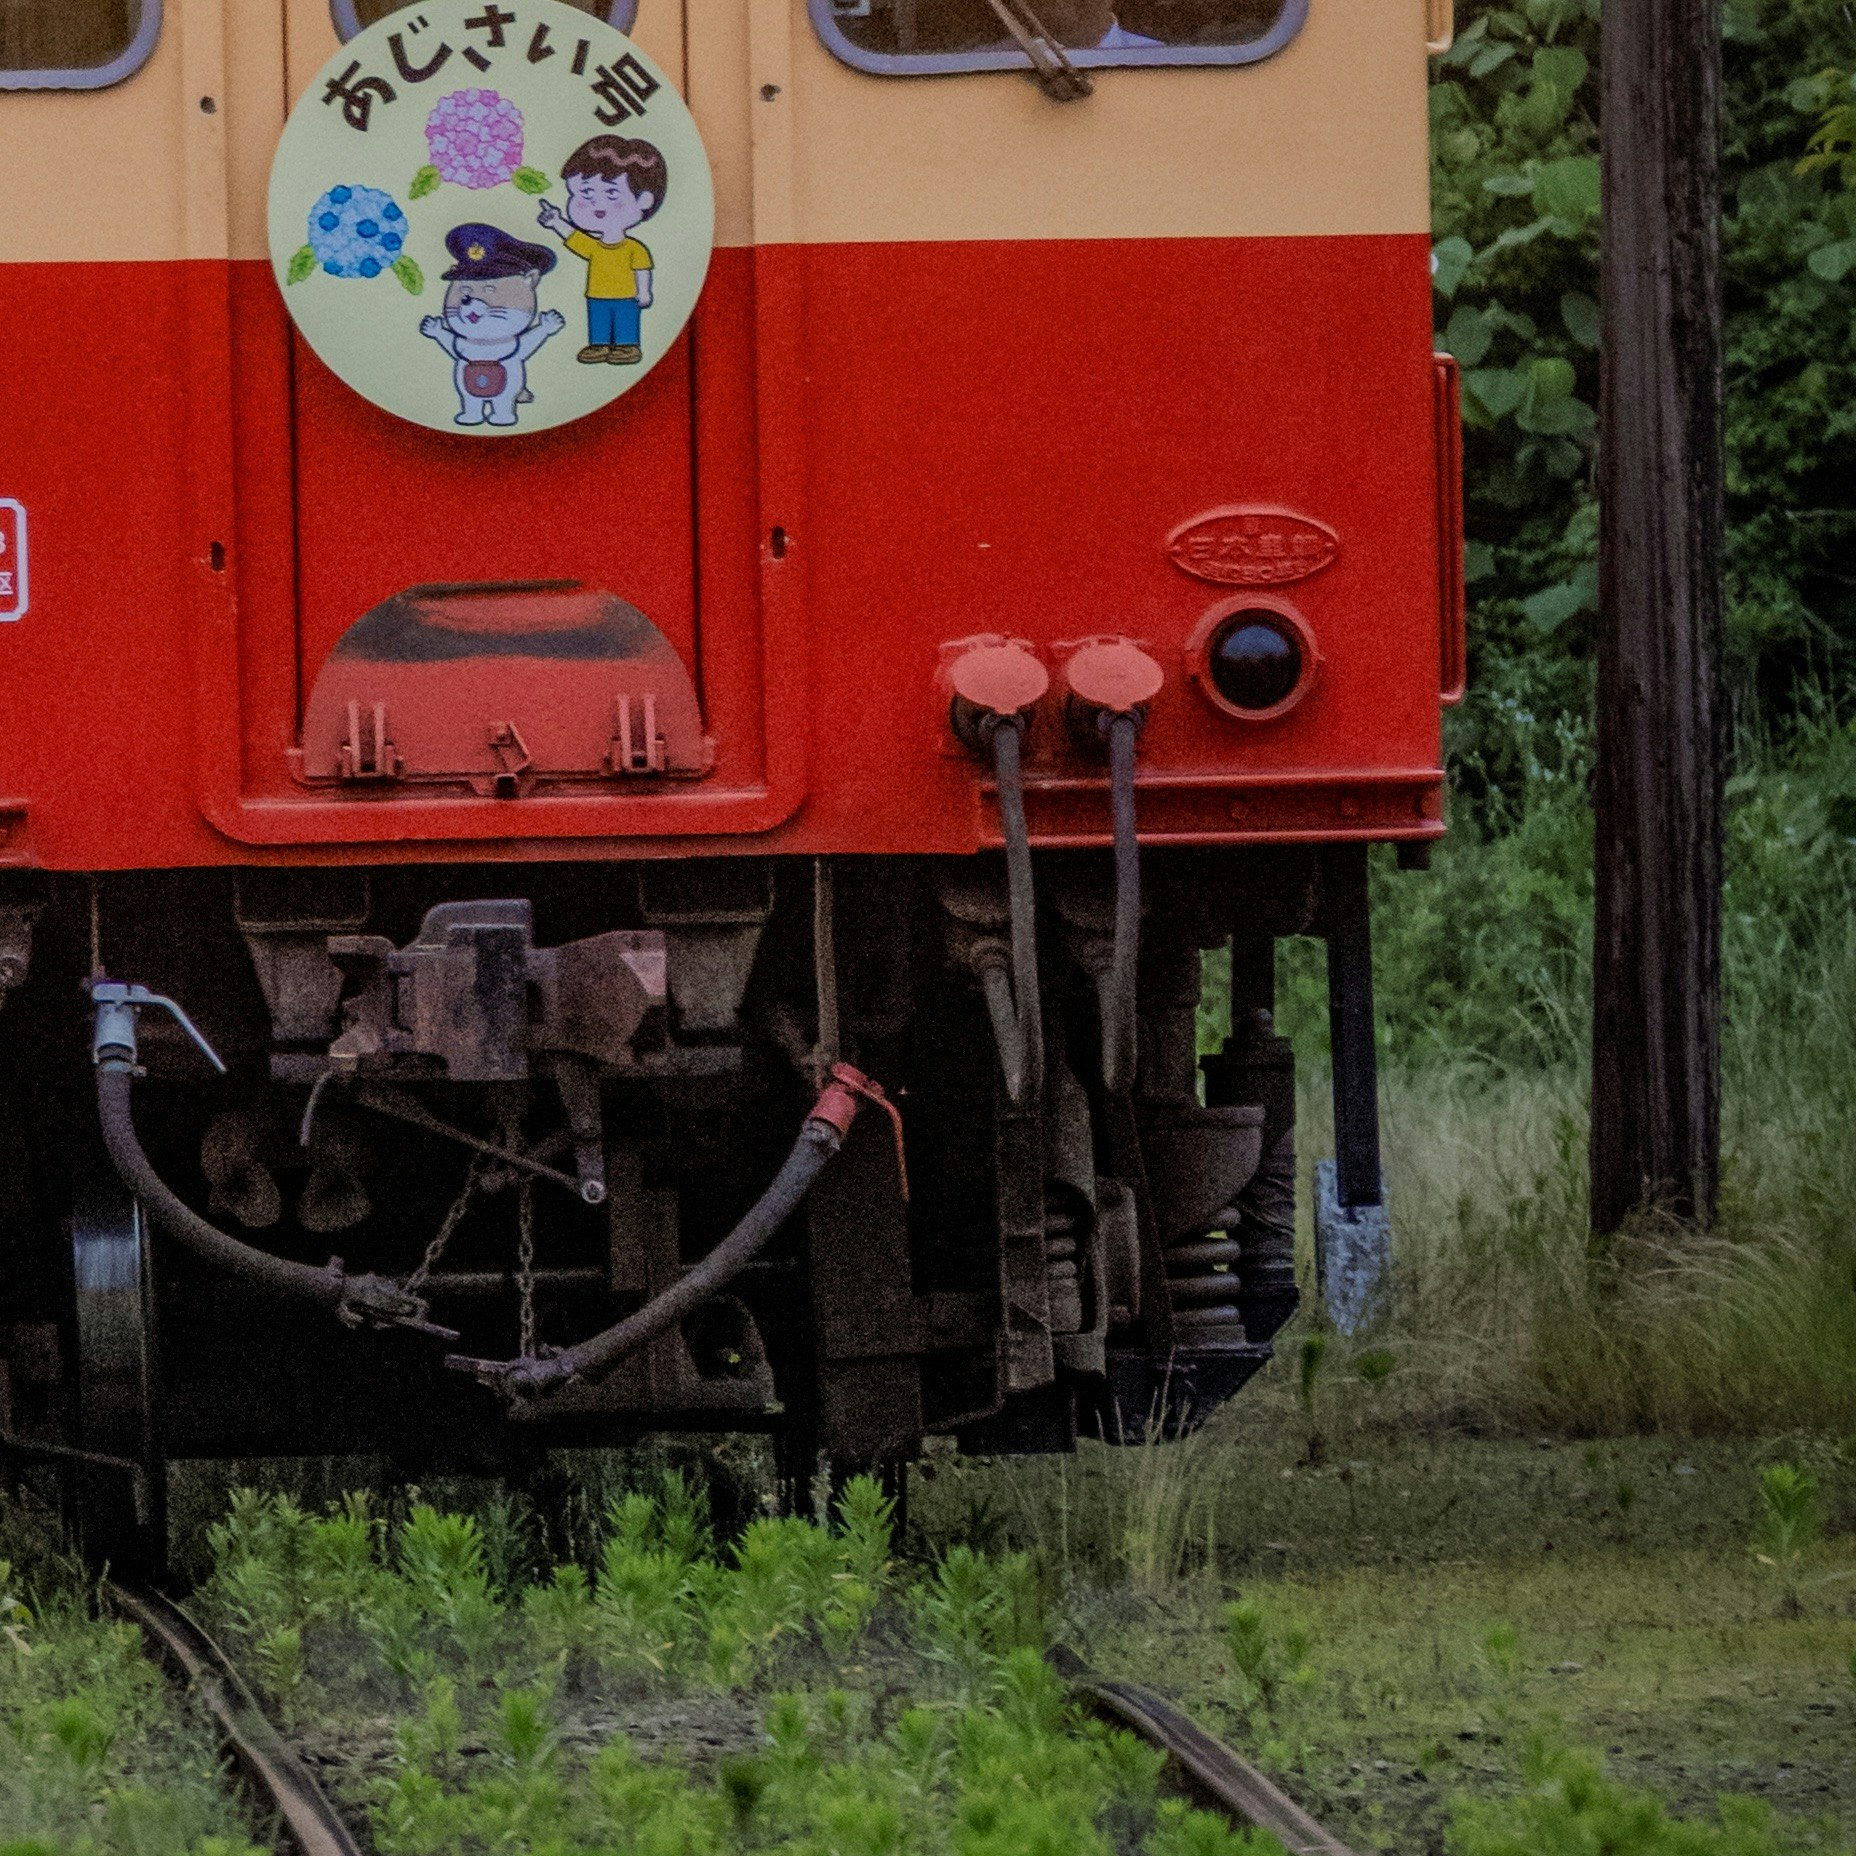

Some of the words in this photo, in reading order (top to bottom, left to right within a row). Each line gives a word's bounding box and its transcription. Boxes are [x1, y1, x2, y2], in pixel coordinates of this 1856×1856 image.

[321, 3, 661, 132] あじさい号
